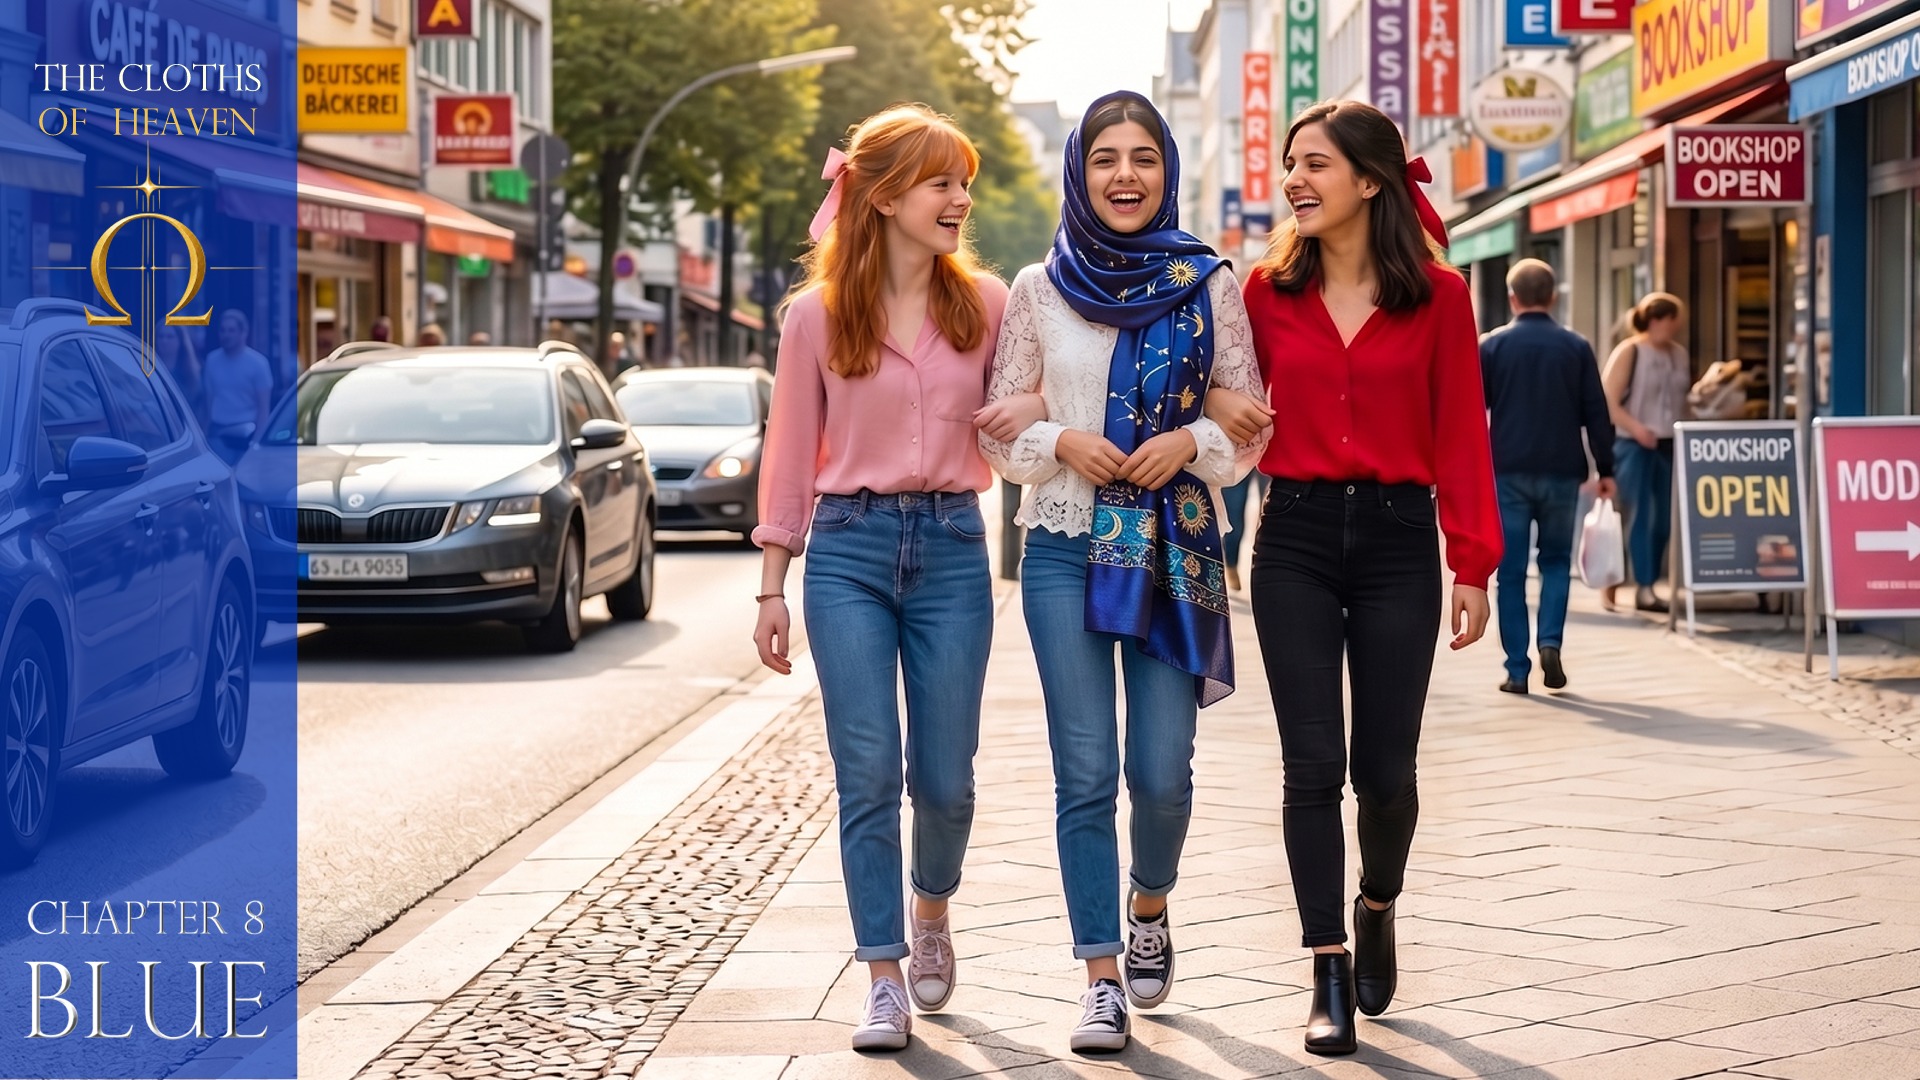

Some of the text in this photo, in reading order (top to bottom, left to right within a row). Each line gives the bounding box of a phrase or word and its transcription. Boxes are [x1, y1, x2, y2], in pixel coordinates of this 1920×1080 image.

[166, 19, 200, 87] DE
[1641, 0, 1755, 92] BOOKSHOP
[1847, 38, 1909, 94] BOOKSHOP
[303, 63, 401, 84] DEUTSCHE
[1246, 56, 1268, 199] CARSI
[1677, 136, 1800, 164] BOOKSHOP
[1693, 169, 1782, 197] OPEN
[1690, 437, 1791, 462] BOOKSHOP
[1696, 475, 1790, 518] OPEN
